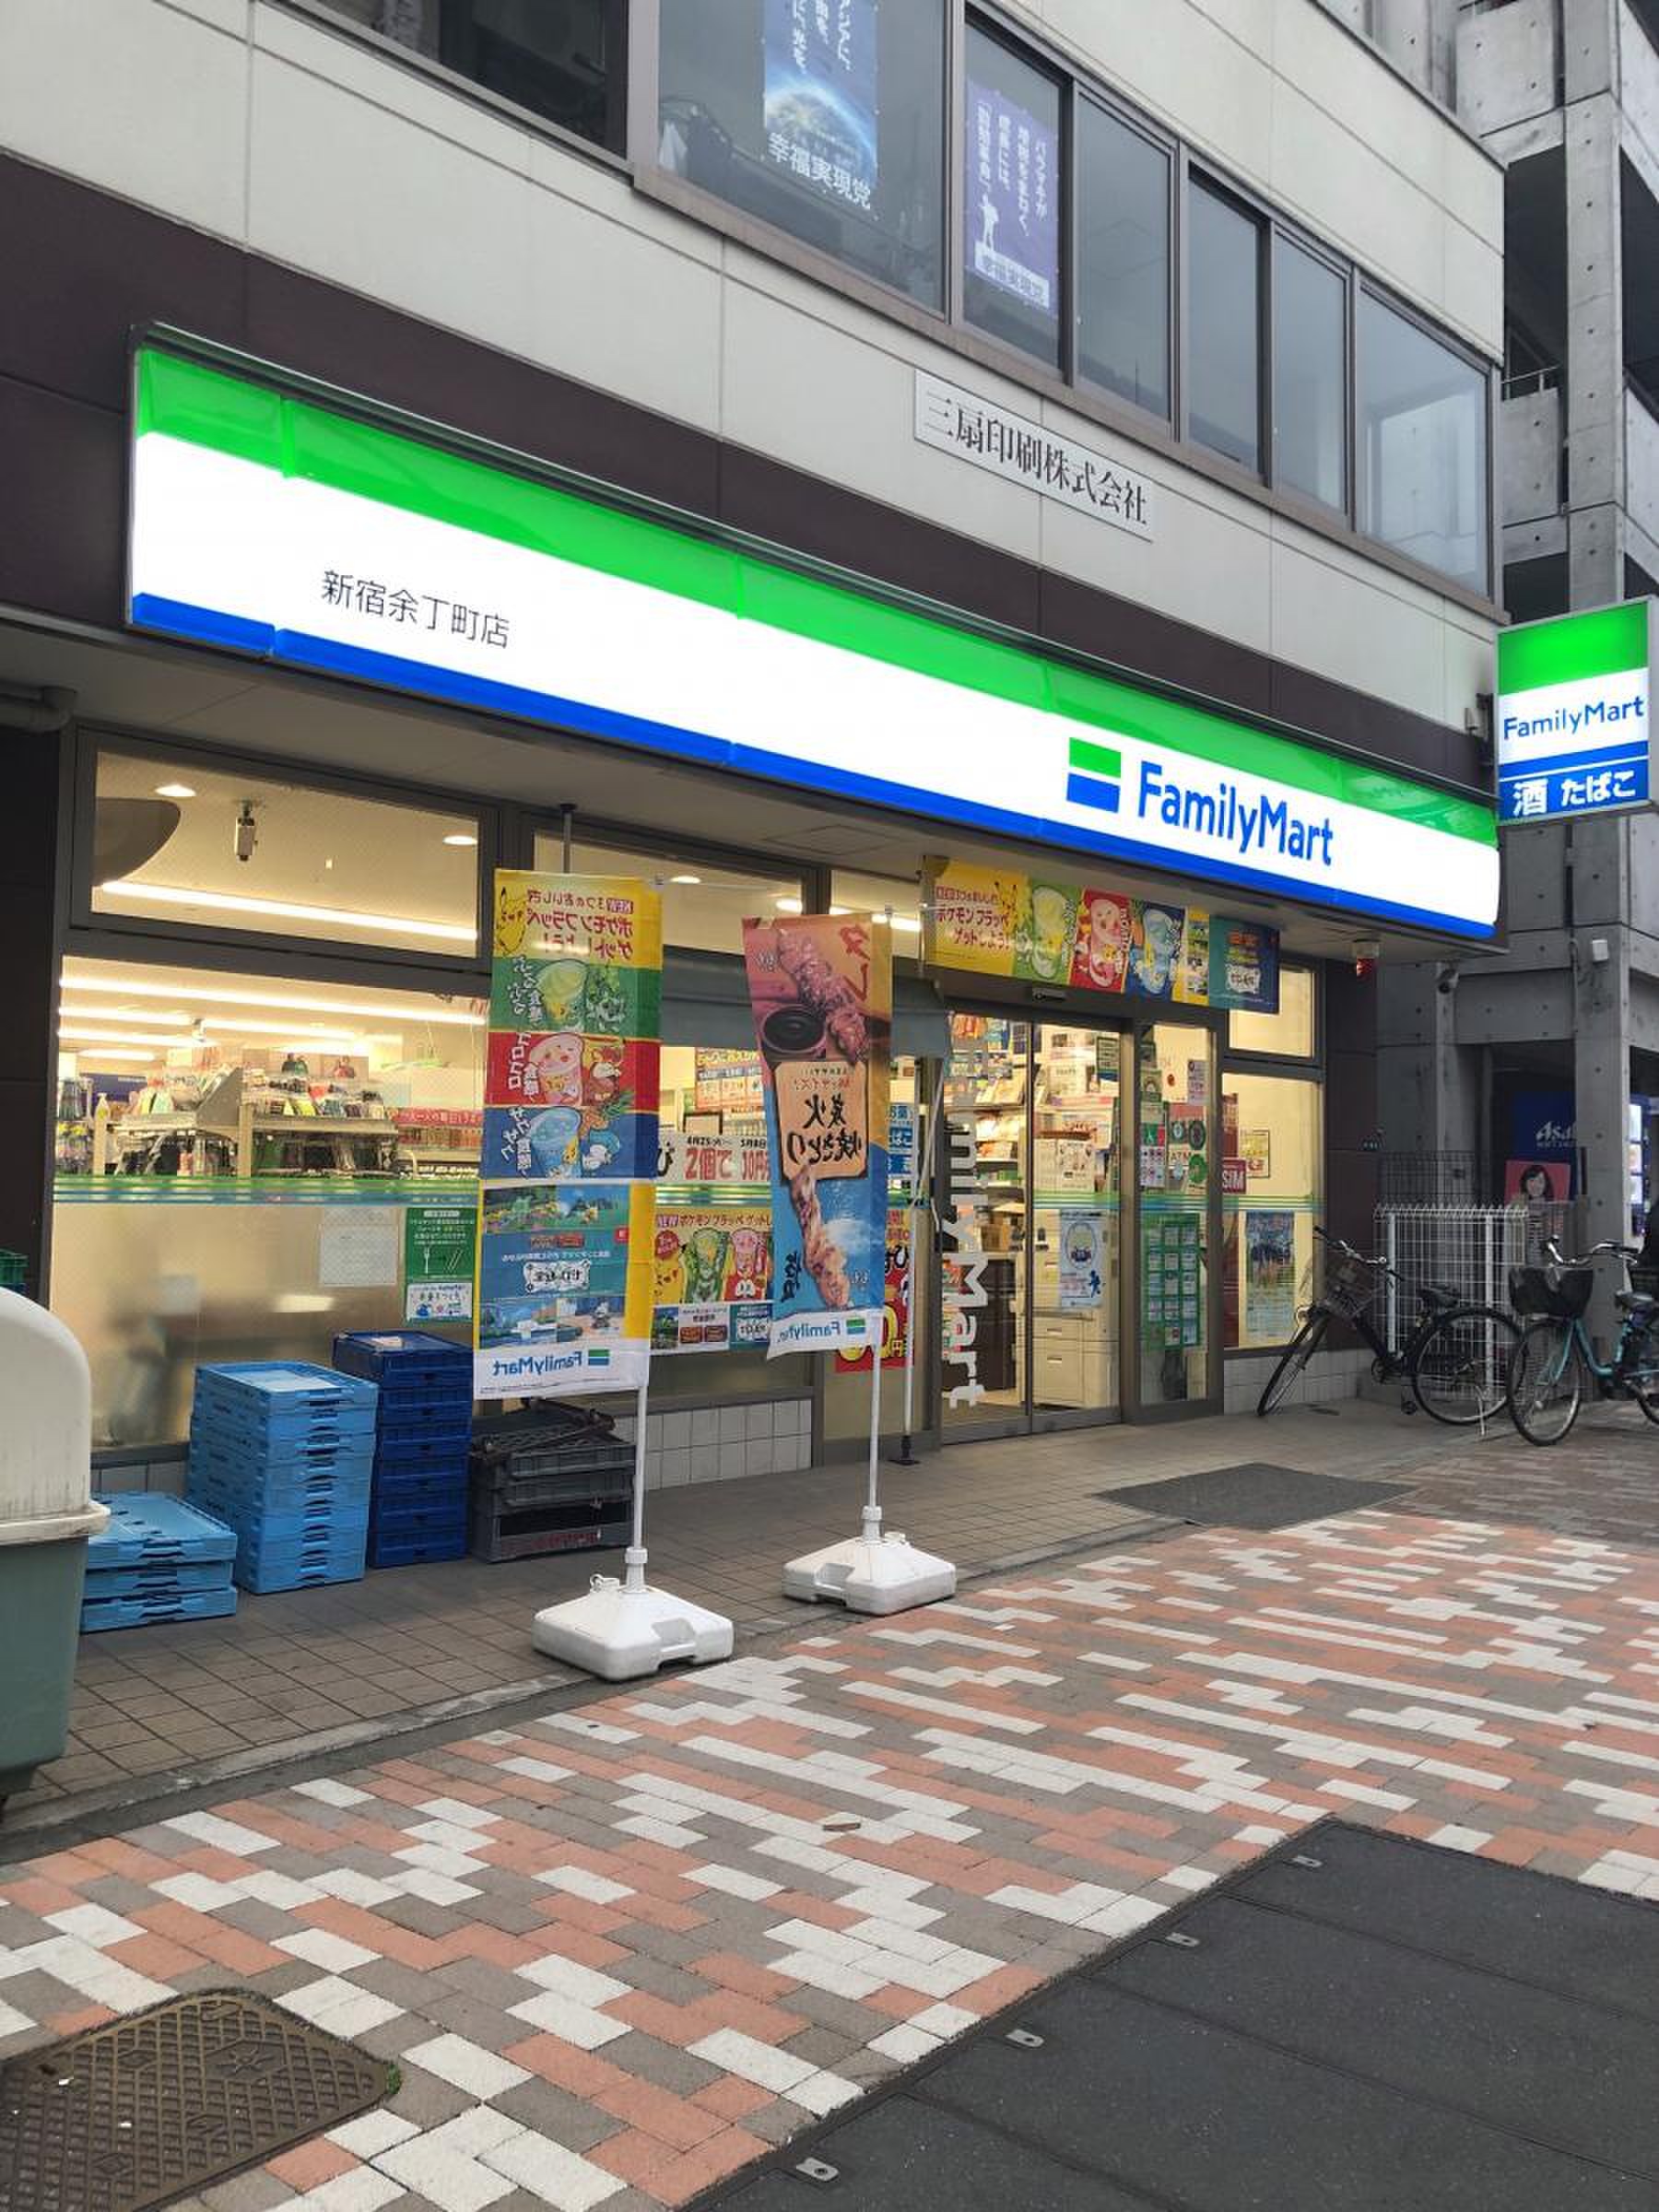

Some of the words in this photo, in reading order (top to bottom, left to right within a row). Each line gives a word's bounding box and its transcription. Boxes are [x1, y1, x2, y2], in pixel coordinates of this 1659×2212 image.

[925, 392, 1147, 525] 三扇印刷株式会社
[322, 570, 509, 648] 新宿余丁町店
[1503, 696, 1644, 740] FamilyMart
[1138, 759, 1333, 866] FamilyMart
[1513, 778, 1548, 816] 酒
[1560, 770, 1636, 806] たばこ
